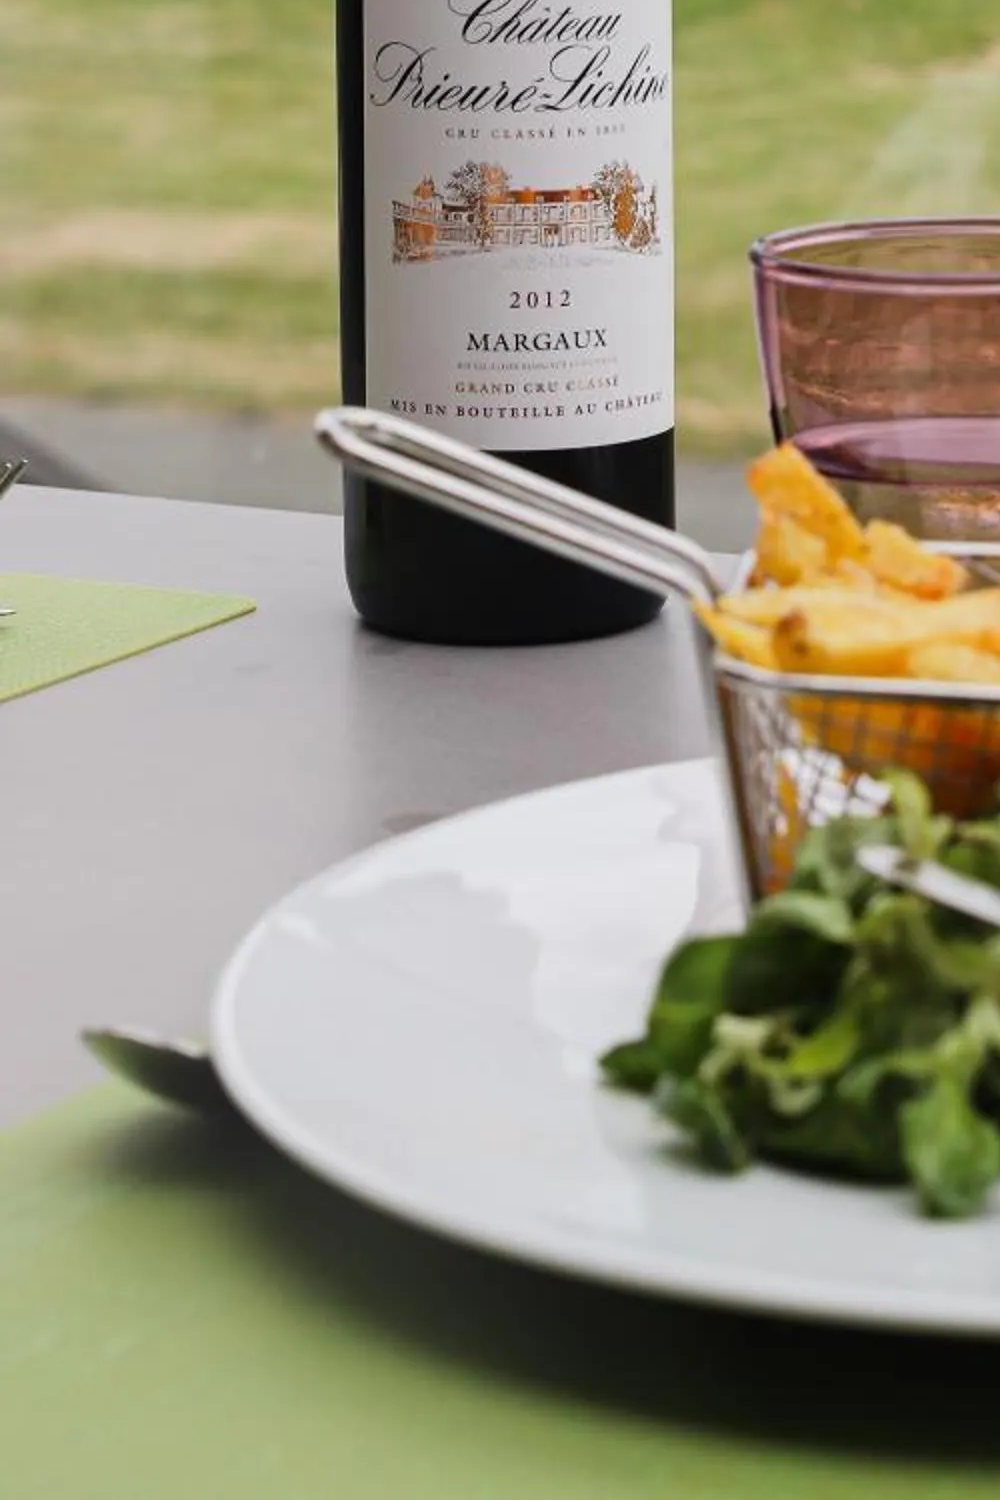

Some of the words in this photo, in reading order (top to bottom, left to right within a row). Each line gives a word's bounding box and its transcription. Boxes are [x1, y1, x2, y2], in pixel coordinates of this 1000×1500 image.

[445, 127, 480, 140] CRU
[567, 127, 587, 138] EN
[509, 289, 572, 309] 2012
[467, 328, 608, 352] MARGAUX
[455, 382, 515, 395] GRAND
[523, 381, 559, 394] CRU
[391, 398, 417, 414] MIS
[424, 402, 448, 416] EN
[456, 404, 565, 418] BOUTEILLE
[574, 402, 597, 416] AU
